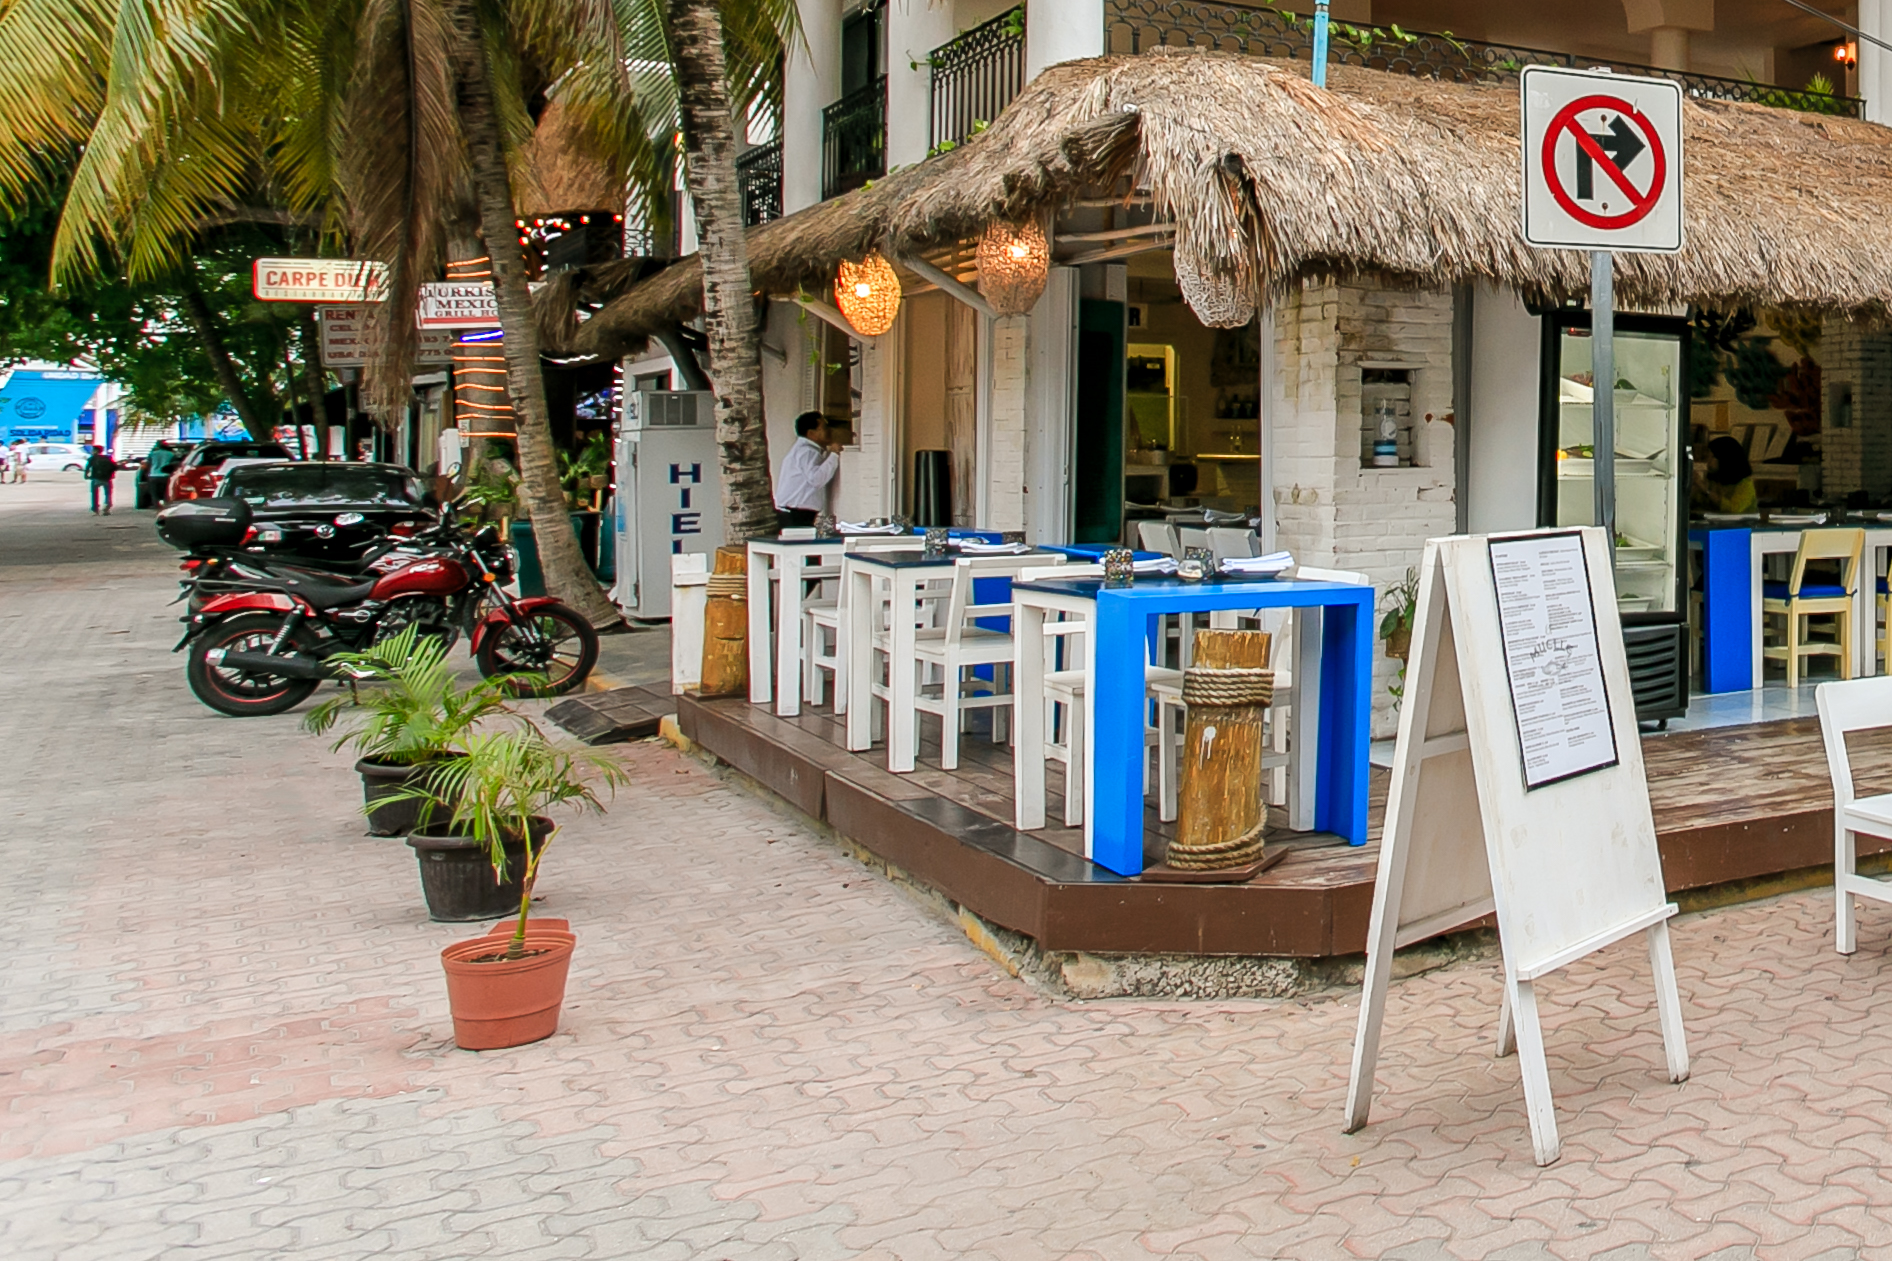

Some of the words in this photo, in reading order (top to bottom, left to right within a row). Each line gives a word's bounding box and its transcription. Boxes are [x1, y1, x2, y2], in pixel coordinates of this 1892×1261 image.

[266, 270, 328, 287] CARPE
[421, 286, 496, 298] TURKIS
[436, 299, 498, 309] MEXIC
[434, 310, 476, 318] GRILL
